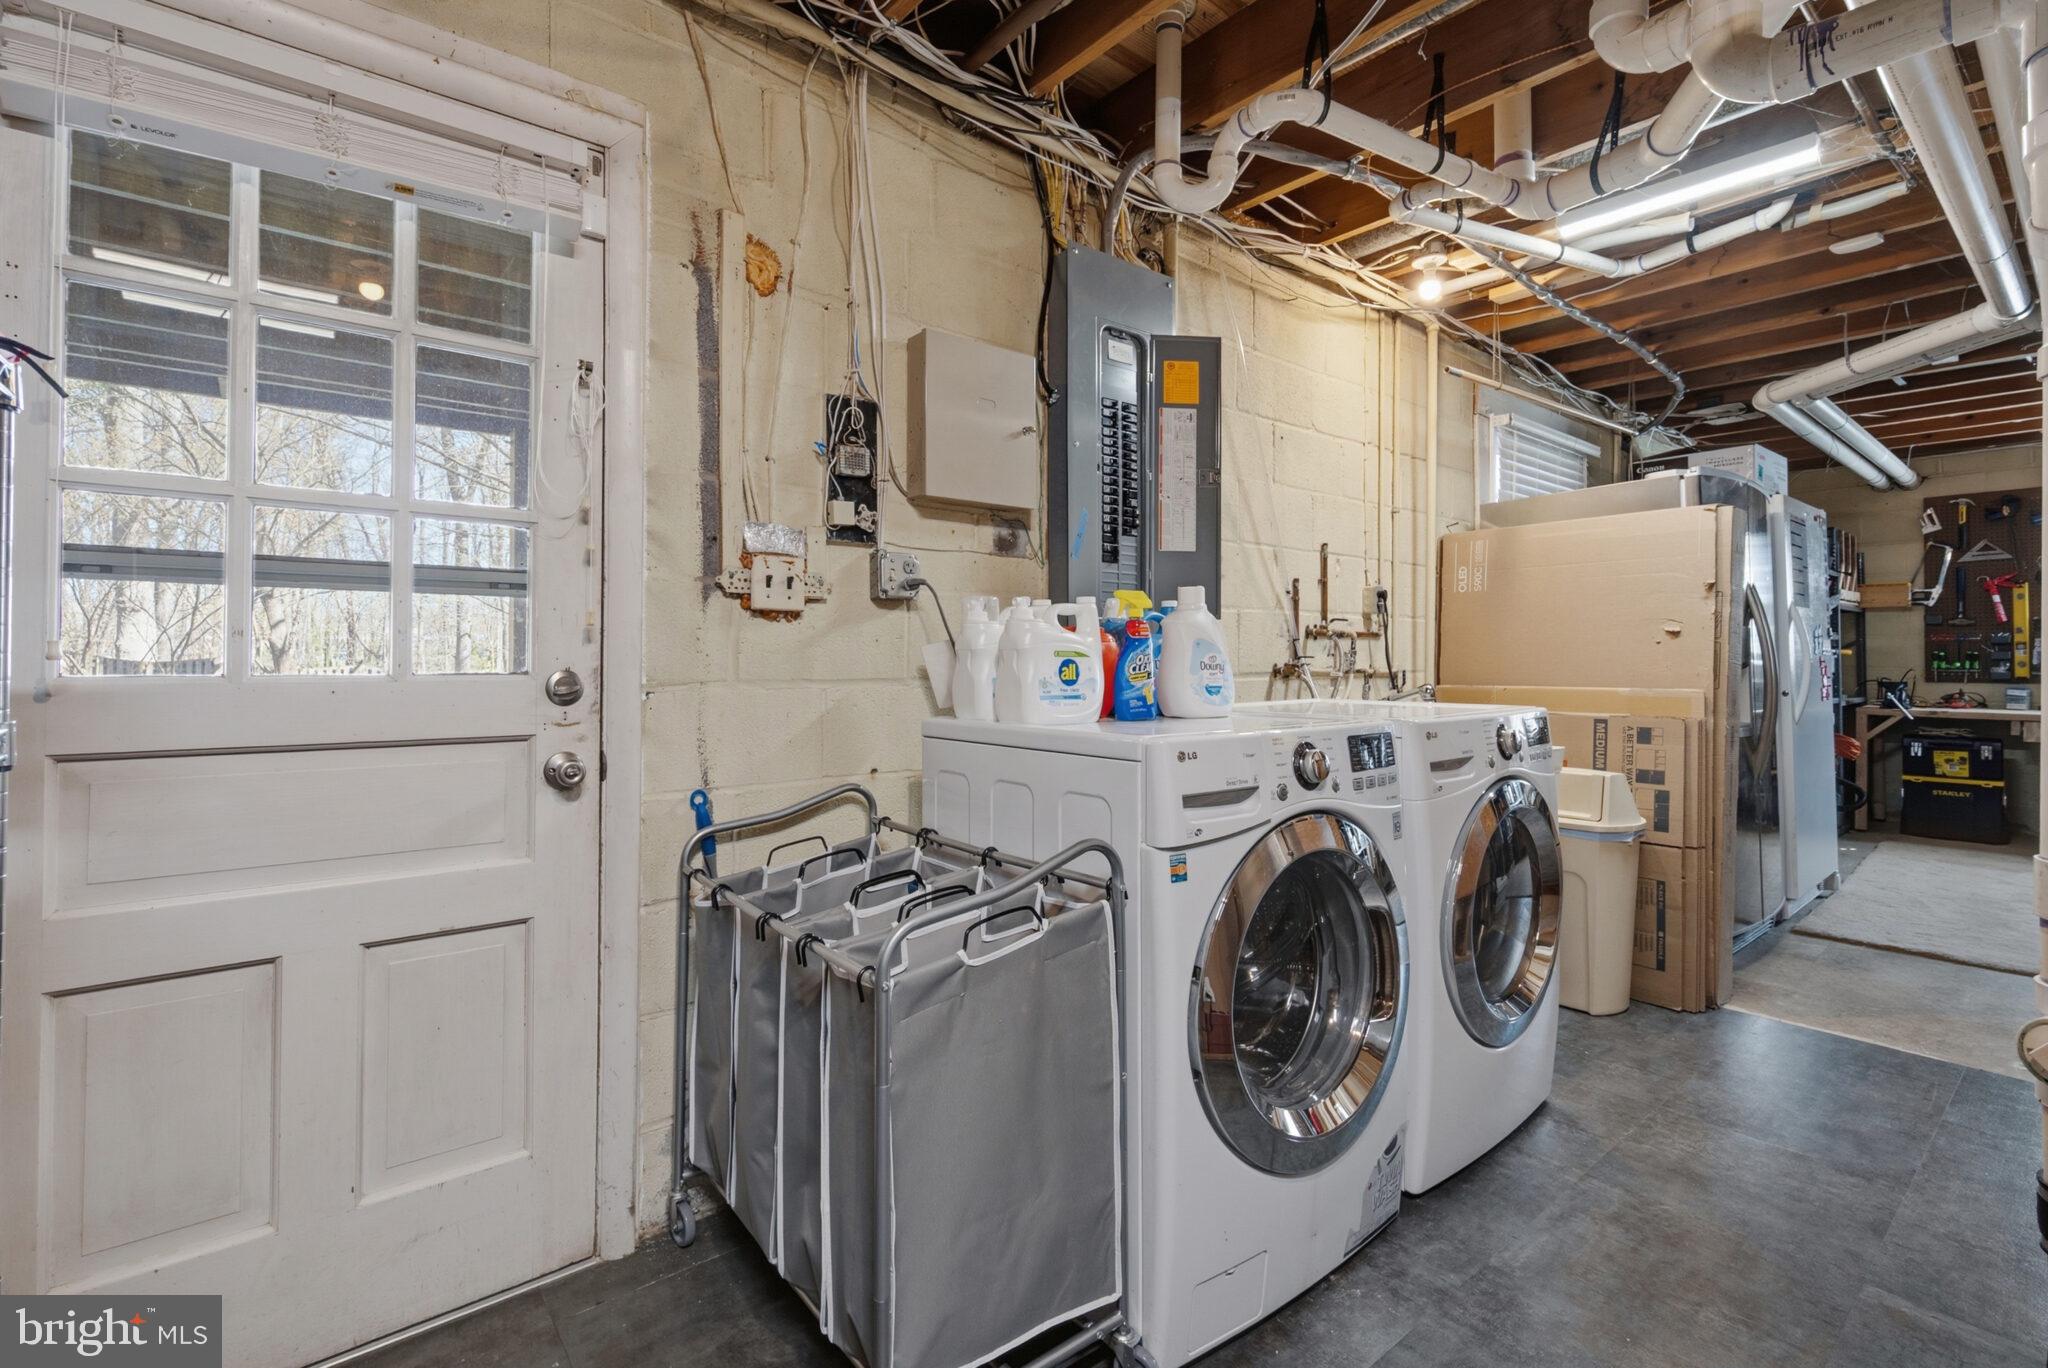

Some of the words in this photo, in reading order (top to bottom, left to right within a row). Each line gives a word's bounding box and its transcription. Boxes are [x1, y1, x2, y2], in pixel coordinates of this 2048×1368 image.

[1636, 464, 1665, 474] Canon
[1458, 566, 1468, 593] OLED
[1060, 663, 1077, 681] all
[1200, 660, 1225, 675] Downy
[1595, 722, 1606, 769] MEDIUM
[1625, 733, 1635, 767] BETTER
[1932, 789, 1970, 798] STANLEY
